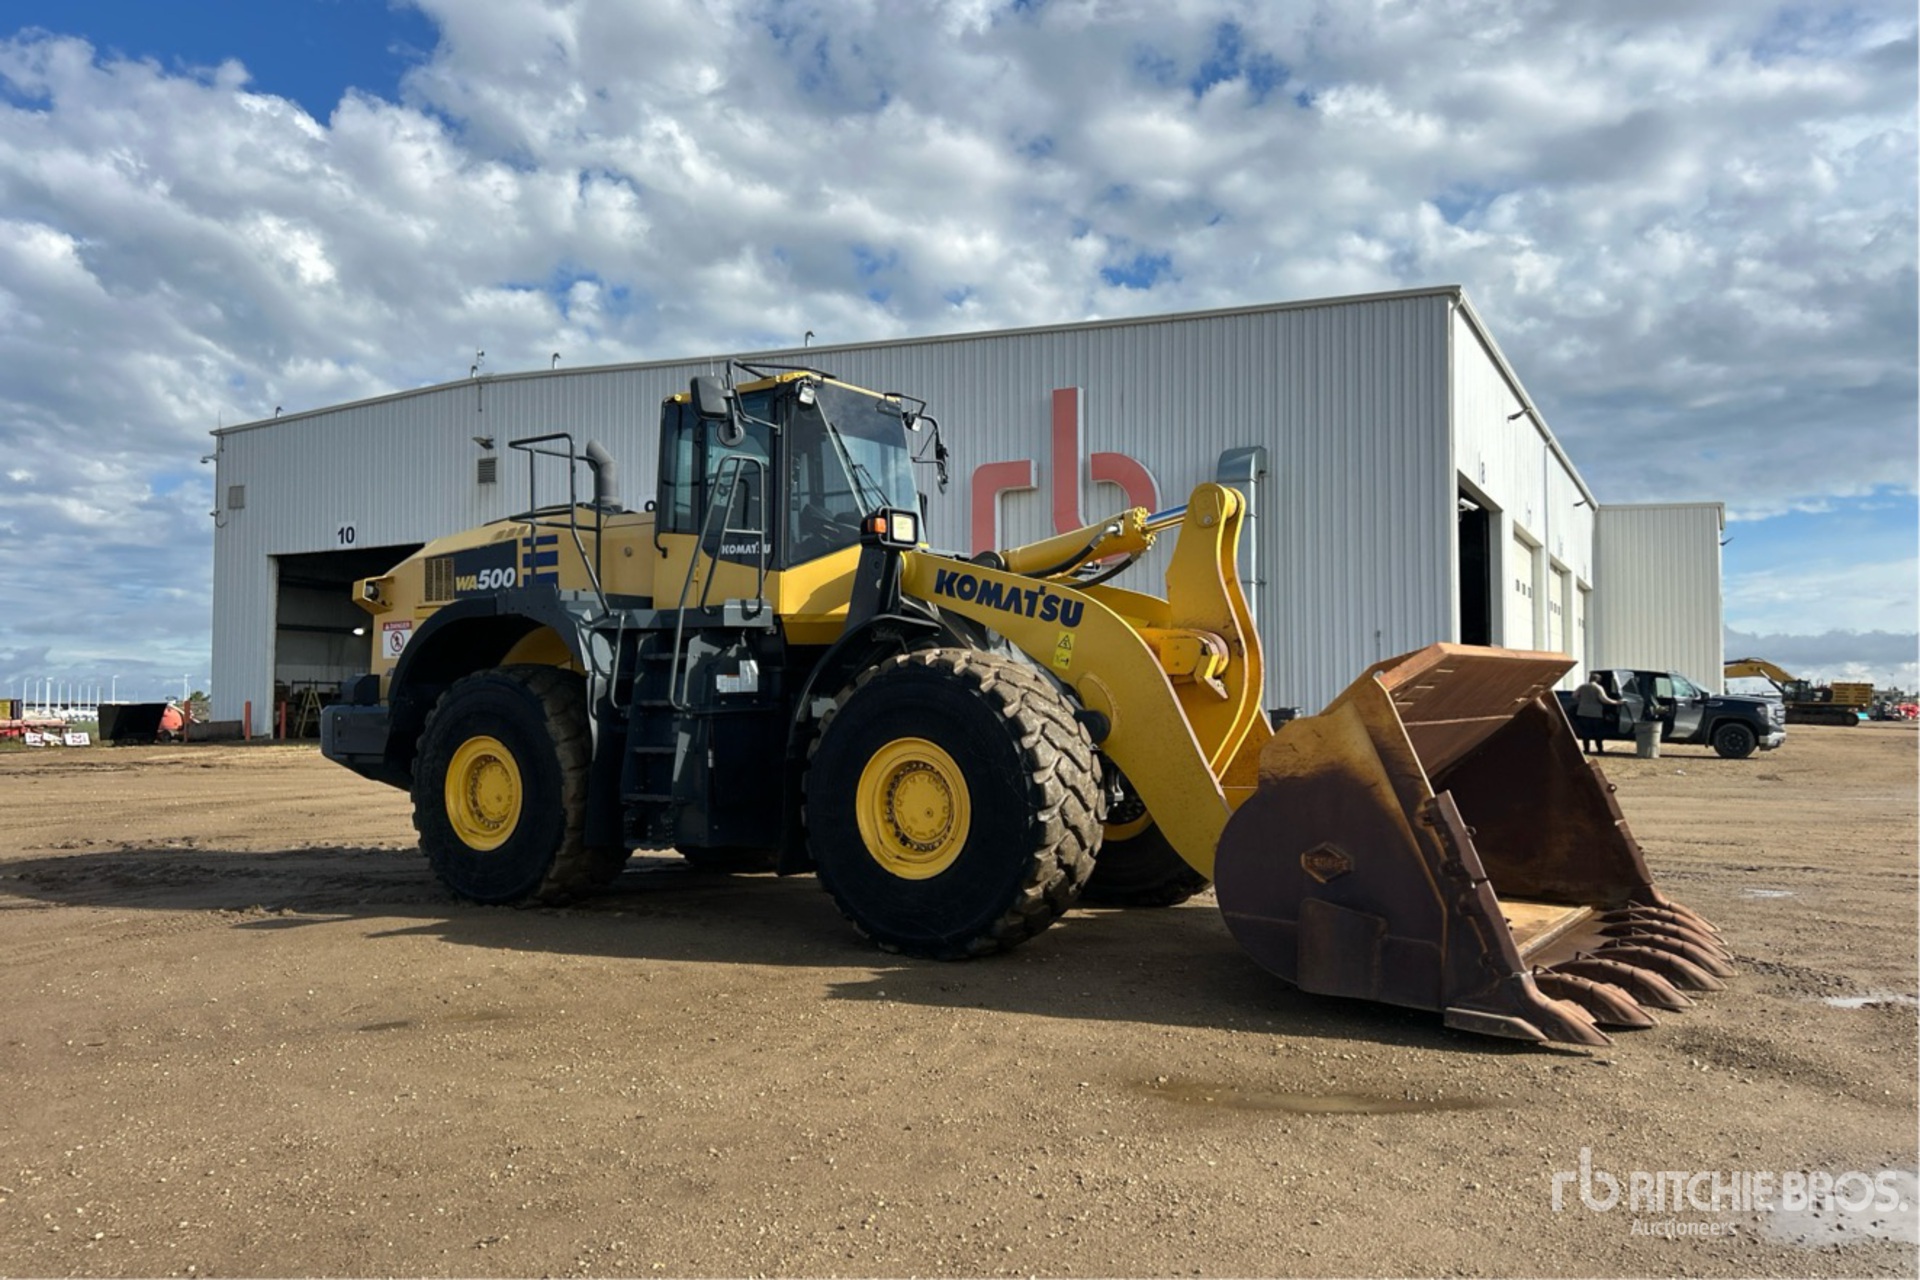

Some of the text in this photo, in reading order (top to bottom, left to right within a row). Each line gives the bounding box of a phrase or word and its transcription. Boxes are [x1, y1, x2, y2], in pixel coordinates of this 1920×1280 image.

[337, 526, 355, 545] 10
[455, 567, 516, 591] WA500
[934, 568, 1085, 628] KOMATSU
